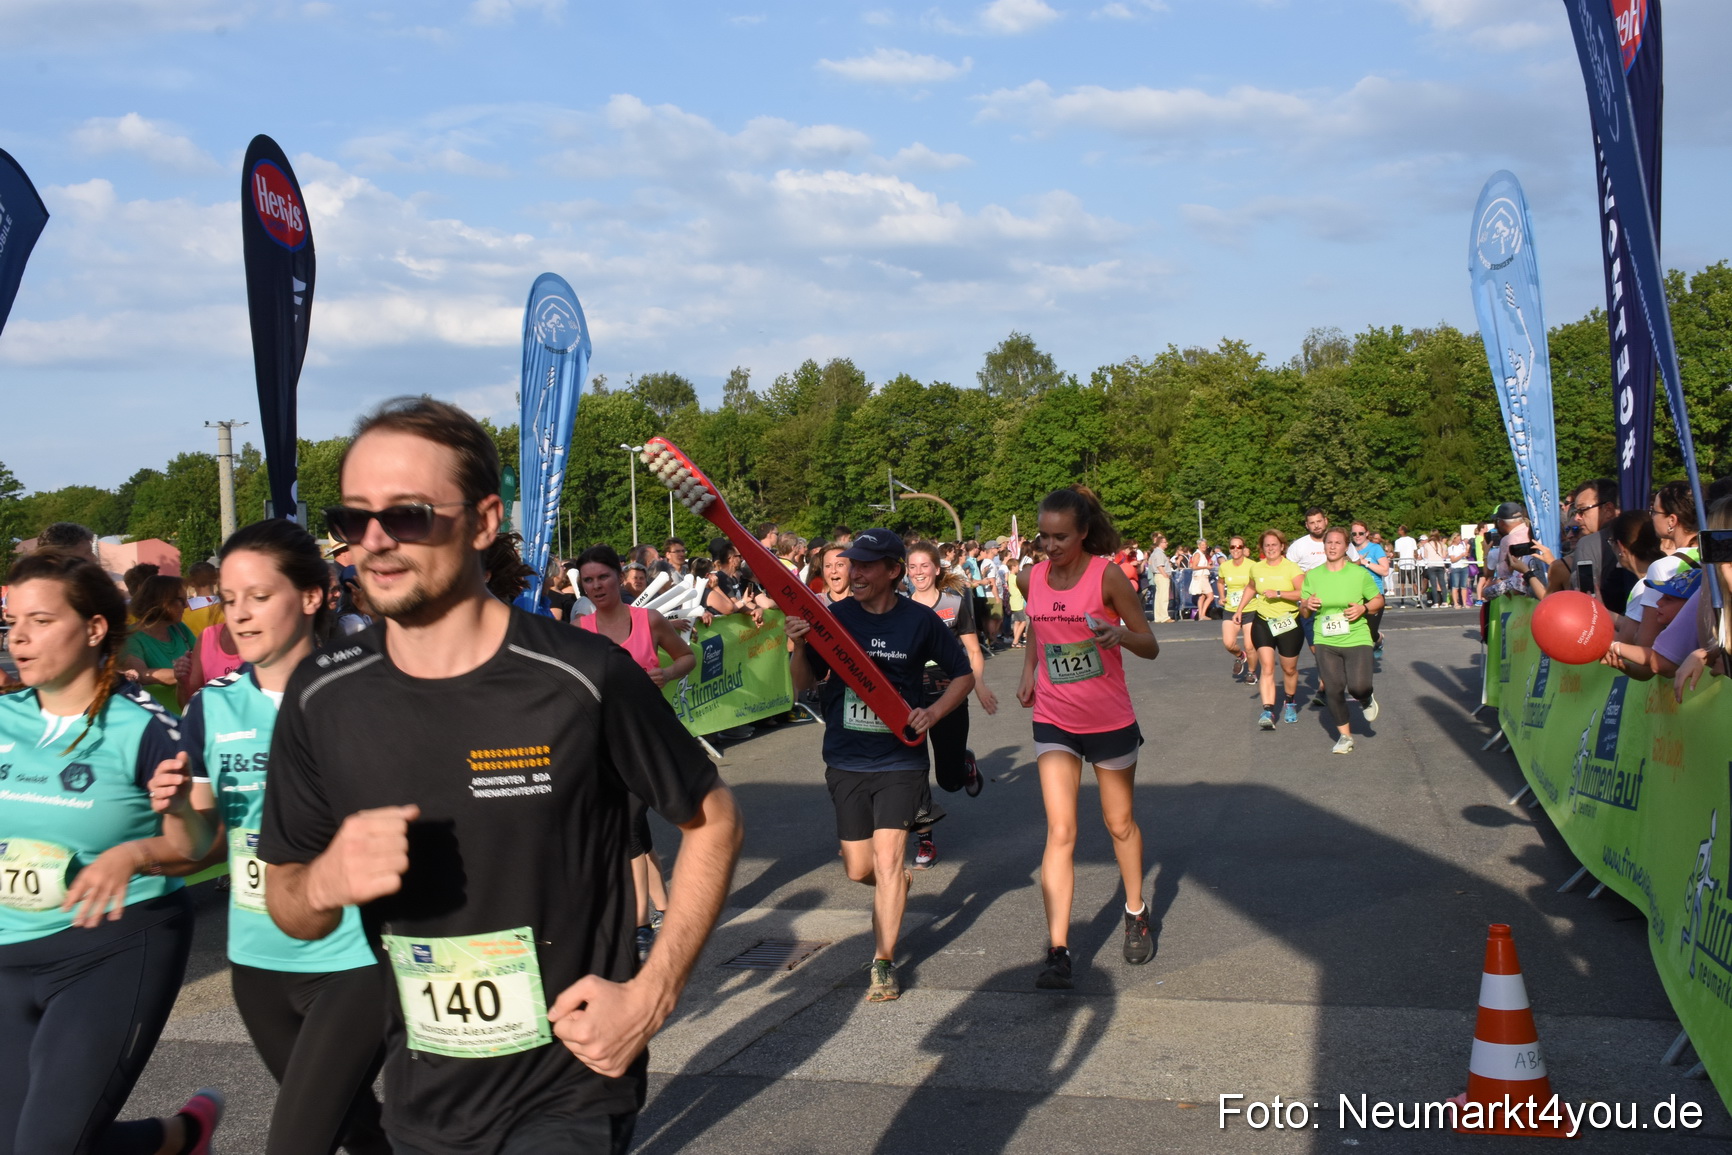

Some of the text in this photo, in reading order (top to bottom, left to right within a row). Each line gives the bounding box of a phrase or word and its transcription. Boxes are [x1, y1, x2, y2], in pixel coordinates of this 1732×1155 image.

[255, 173, 303, 232] Hervis
[0, 214, 13, 257] OBILE
[1053, 601, 1066, 612] Die
[1272, 618, 1293, 630] 1233
[1325, 621, 1342, 630] 451
[799, 605, 834, 643] HELMUT
[831, 643, 877, 693] HOFMANN
[871, 638, 886, 649] Die
[1052, 654, 1092, 673] 1121
[689, 662, 743, 711] firmenlauf
[470, 745, 551, 759] BERSCHNEIDER
[220, 752, 269, 773] H&S
[470, 757, 551, 771] BERSCHNEIDER
[0, 869, 40, 895] 70
[422, 980, 501, 1023] 140
